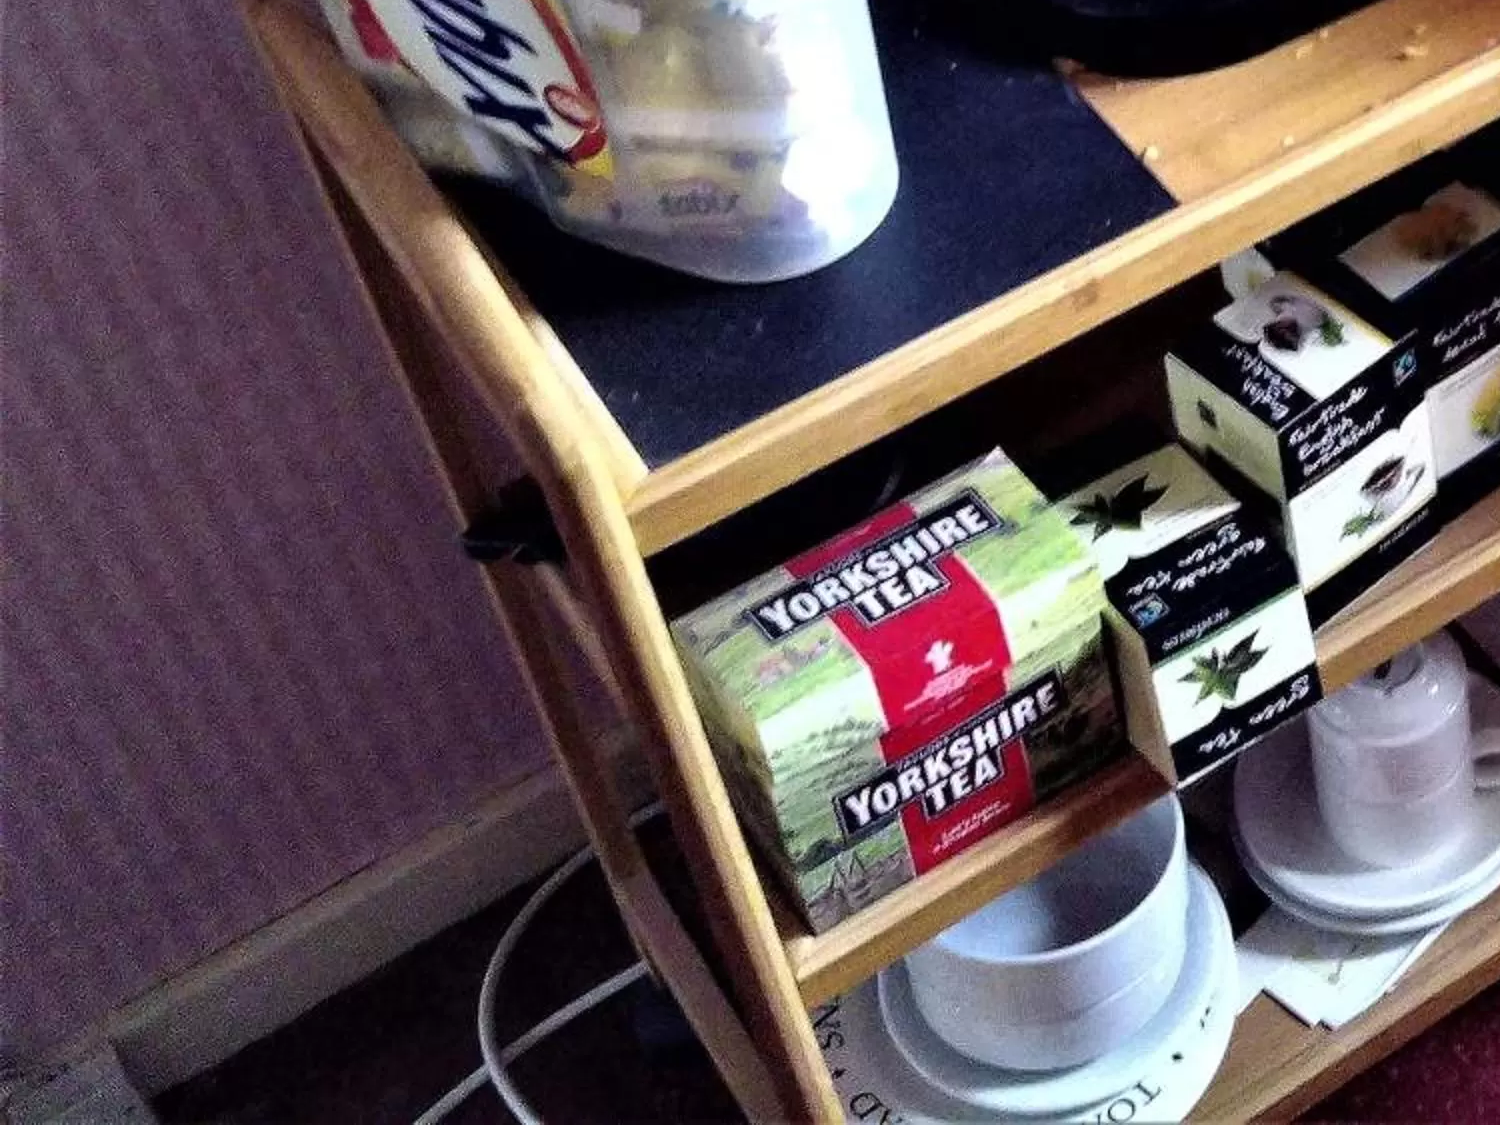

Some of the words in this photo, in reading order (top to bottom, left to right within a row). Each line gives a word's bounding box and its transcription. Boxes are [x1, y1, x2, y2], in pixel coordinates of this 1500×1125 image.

[757, 502, 990, 636] YORKSHIRE
[854, 563, 944, 623] TEA
[843, 679, 1060, 828] YORKSHIRE
[925, 755, 998, 813] TEA
